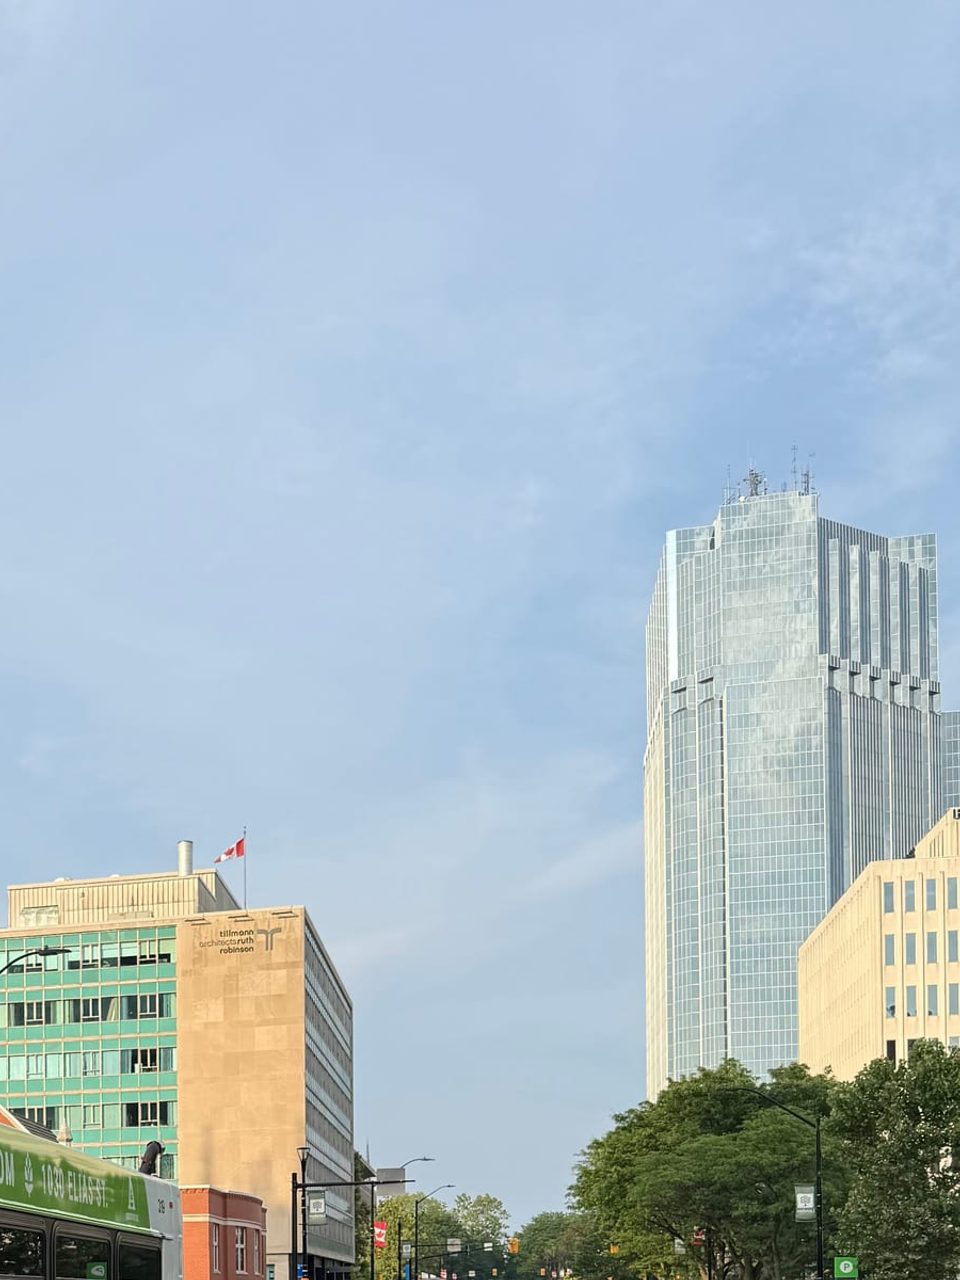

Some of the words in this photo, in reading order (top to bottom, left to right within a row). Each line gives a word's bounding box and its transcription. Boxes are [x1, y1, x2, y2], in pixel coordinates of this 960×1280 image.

[220, 929, 254, 938] tillmann
[237, 936, 254, 945] ruth
[220, 946, 254, 954] robinson
[42, 1164, 64, 1199] 1030
[68, 1170, 94, 1206] ELIAS
[95, 1178, 109, 1209] ST.
